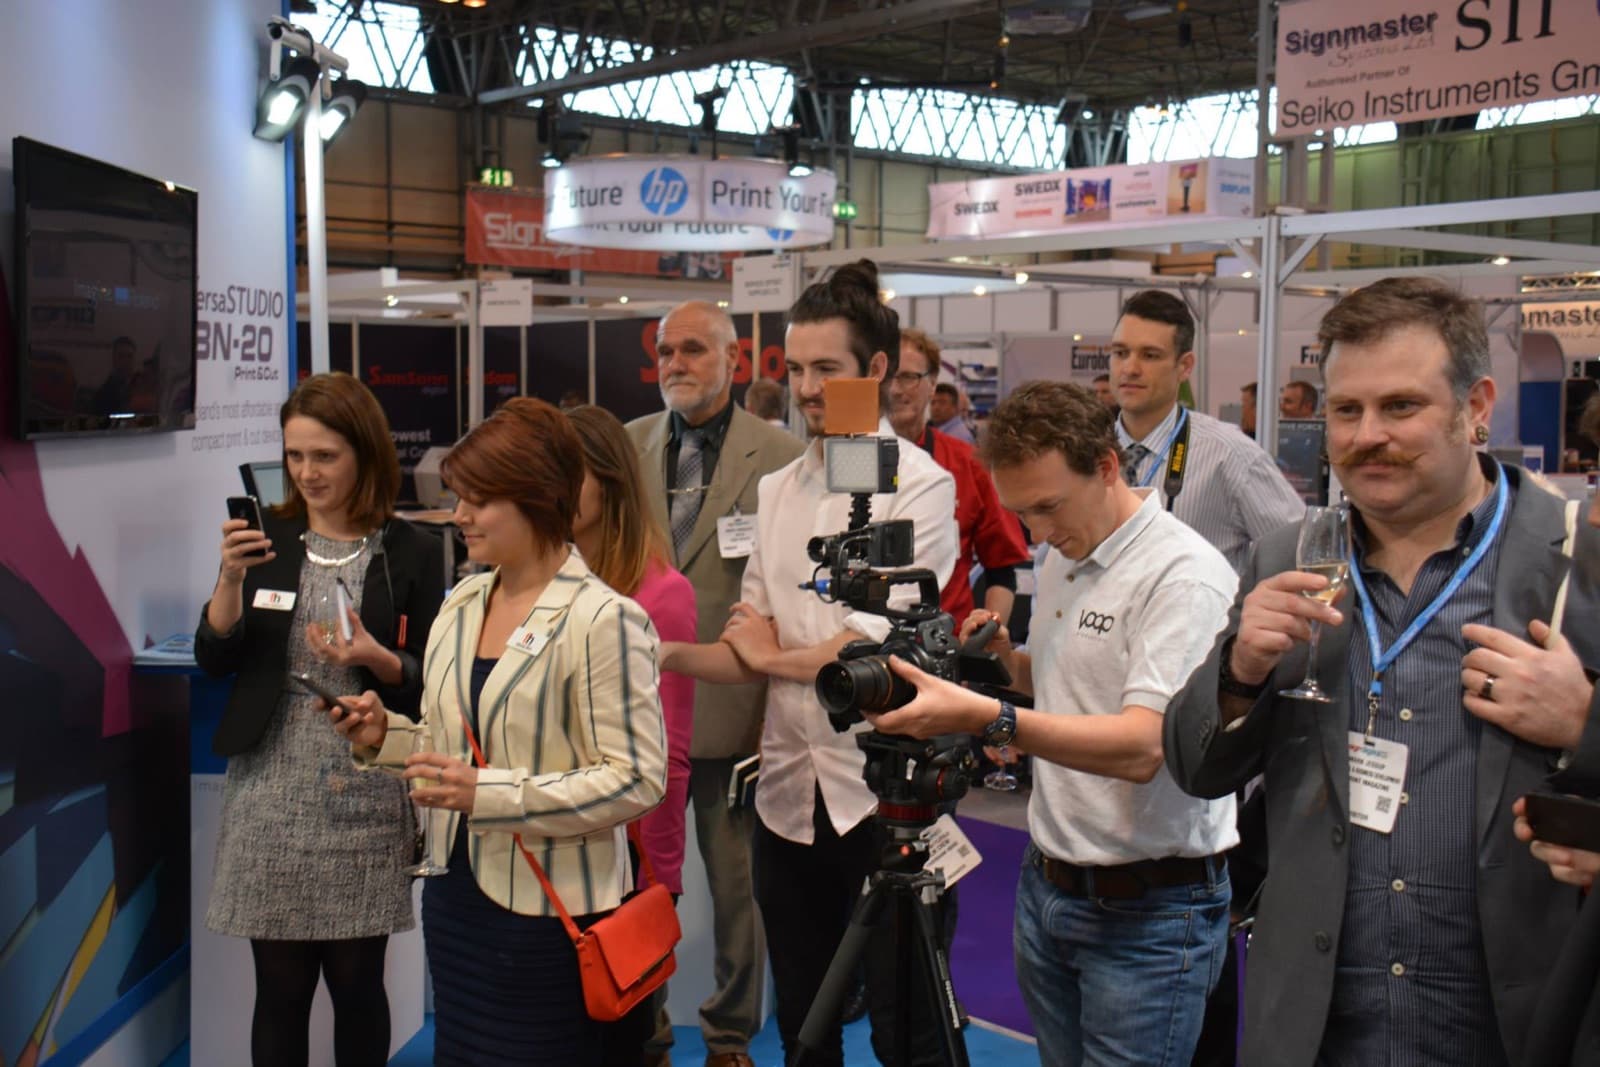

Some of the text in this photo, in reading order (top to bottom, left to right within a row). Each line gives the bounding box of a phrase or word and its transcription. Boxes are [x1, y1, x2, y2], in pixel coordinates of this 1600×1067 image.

[1285, 11, 1438, 57] Signmaster
[1358, 69, 1396, 82] Partner
[1281, 97, 1354, 128] Seiko
[1363, 71, 1540, 118] Instruments
[641, 166, 688, 216] hp
[711, 179, 773, 210] Print
[780, 185, 817, 214] Your
[234, 365, 279, 381] Print&Cut
